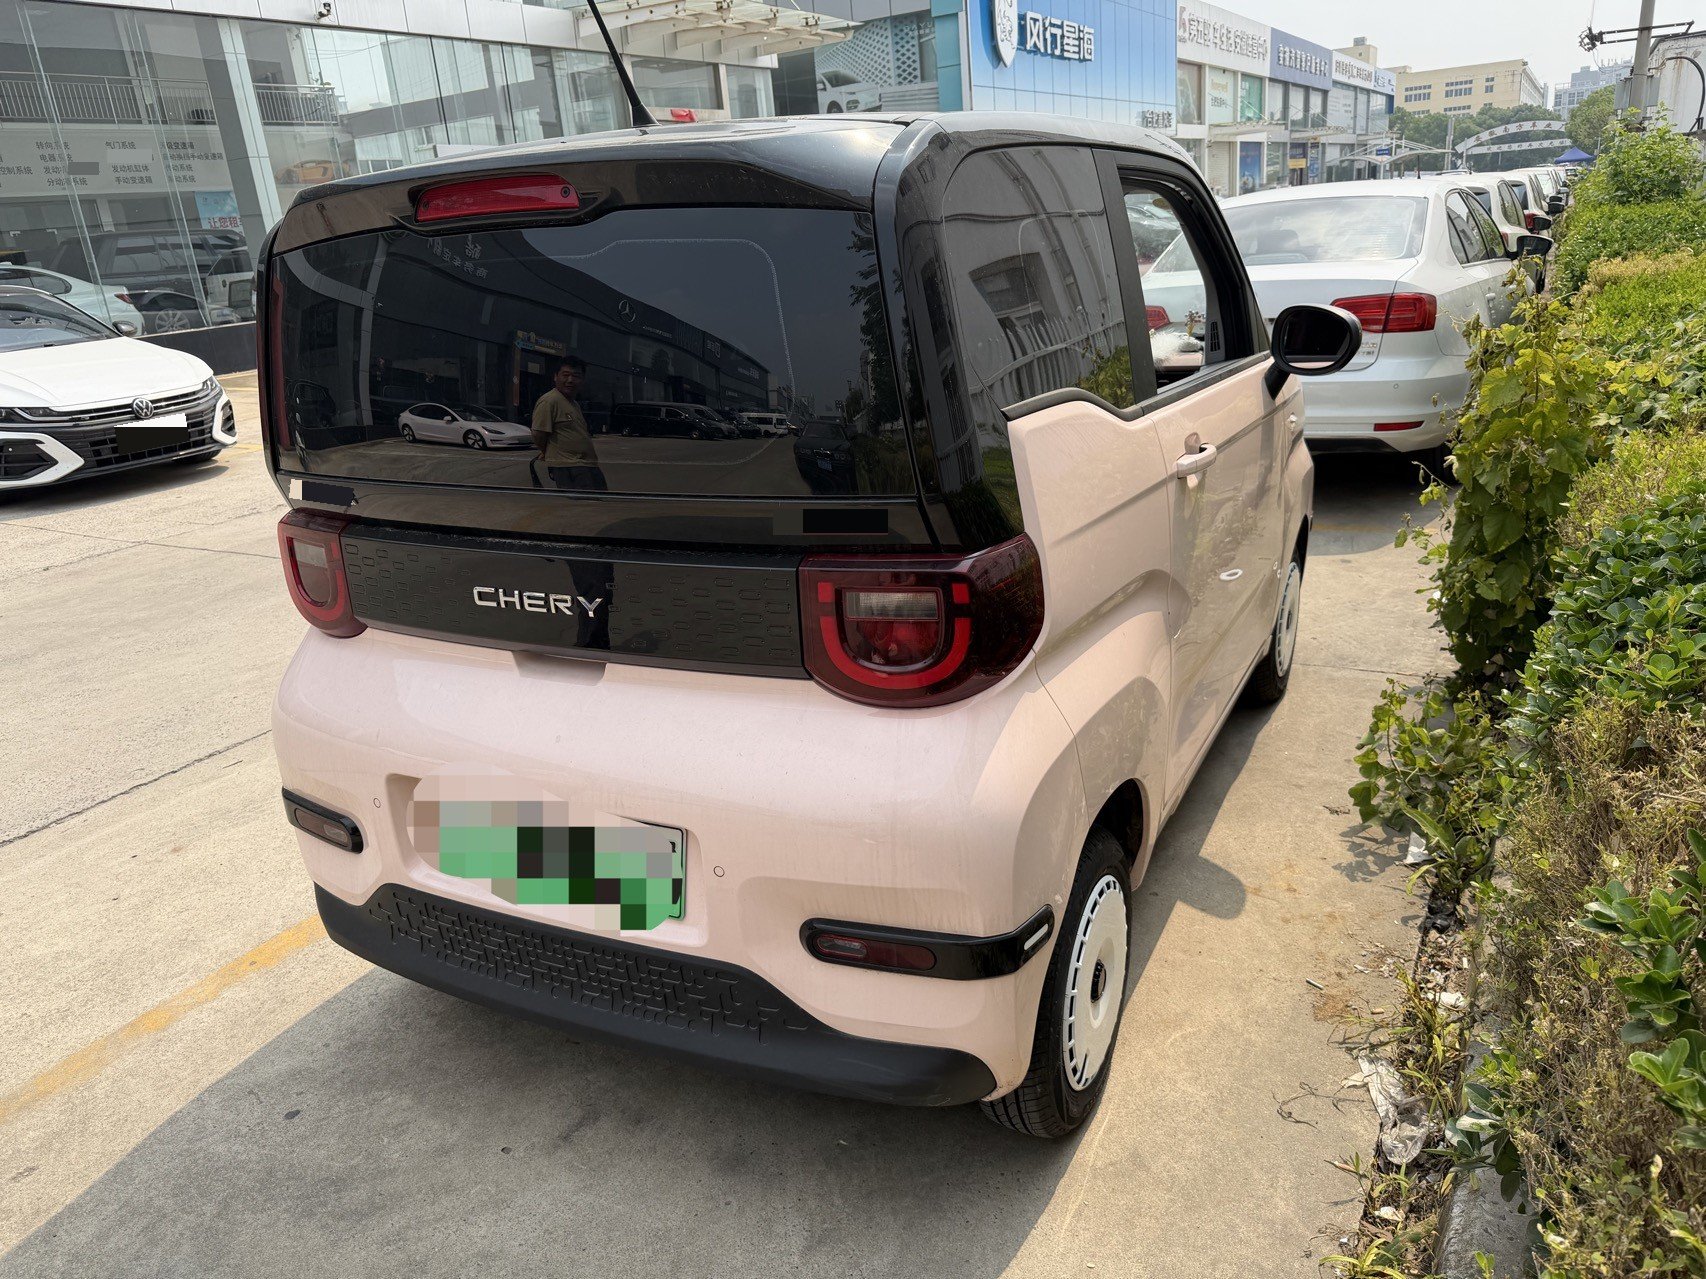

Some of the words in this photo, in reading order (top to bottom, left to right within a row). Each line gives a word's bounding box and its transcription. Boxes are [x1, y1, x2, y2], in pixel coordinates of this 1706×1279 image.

[1025, 11, 1094, 61] 风行星海
[105, 141, 136, 150] 气门系统
[473, 586, 603, 617] CHERY
